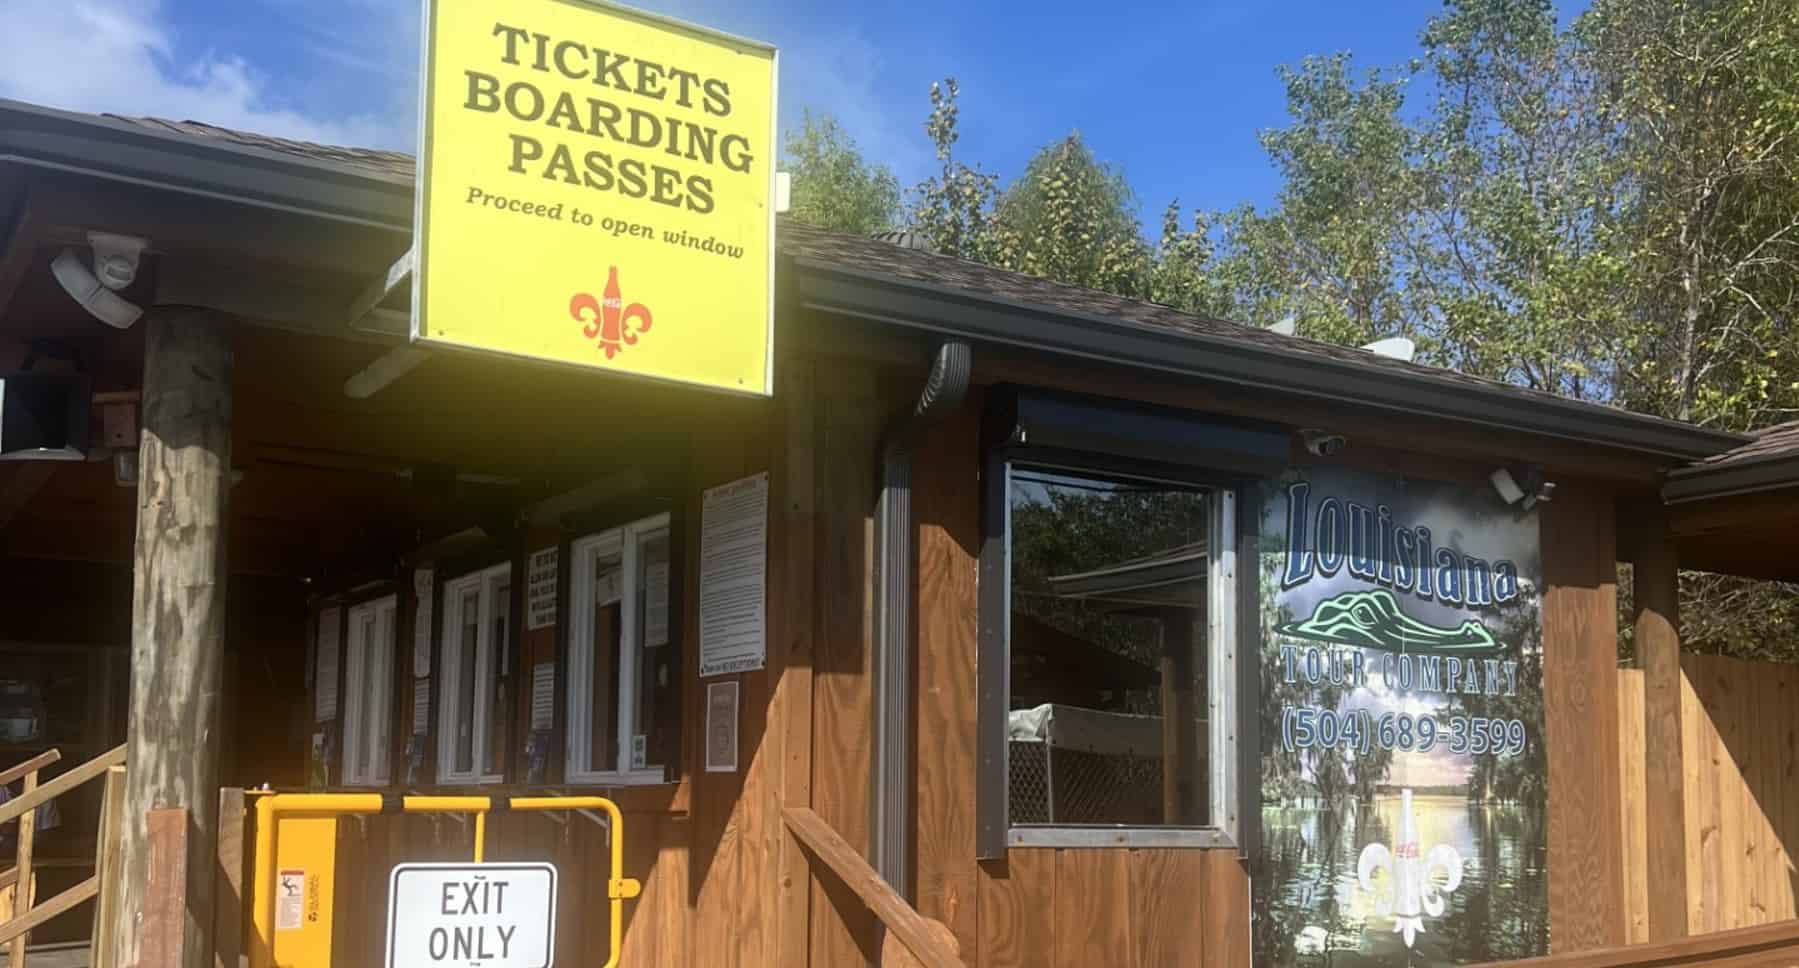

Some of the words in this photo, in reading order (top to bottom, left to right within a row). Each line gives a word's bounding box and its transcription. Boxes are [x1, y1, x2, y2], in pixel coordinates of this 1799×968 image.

[492, 22, 731, 117] TICKETS
[464, 69, 753, 174] BOARDING
[508, 133, 714, 214] PASSES
[466, 187, 563, 220] Proceed
[571, 208, 593, 226] to
[601, 217, 654, 239] open
[663, 229, 744, 260] window
[1282, 481, 1518, 608] Louisiana
[1280, 644, 1367, 688] TOUR
[1383, 653, 1518, 697] COMPANY
[1281, 706, 1370, 756] (504)
[1378, 712, 1526, 757] 689-3599
[441, 881, 509, 915] EXIT
[429, 925, 516, 961] ONLY
